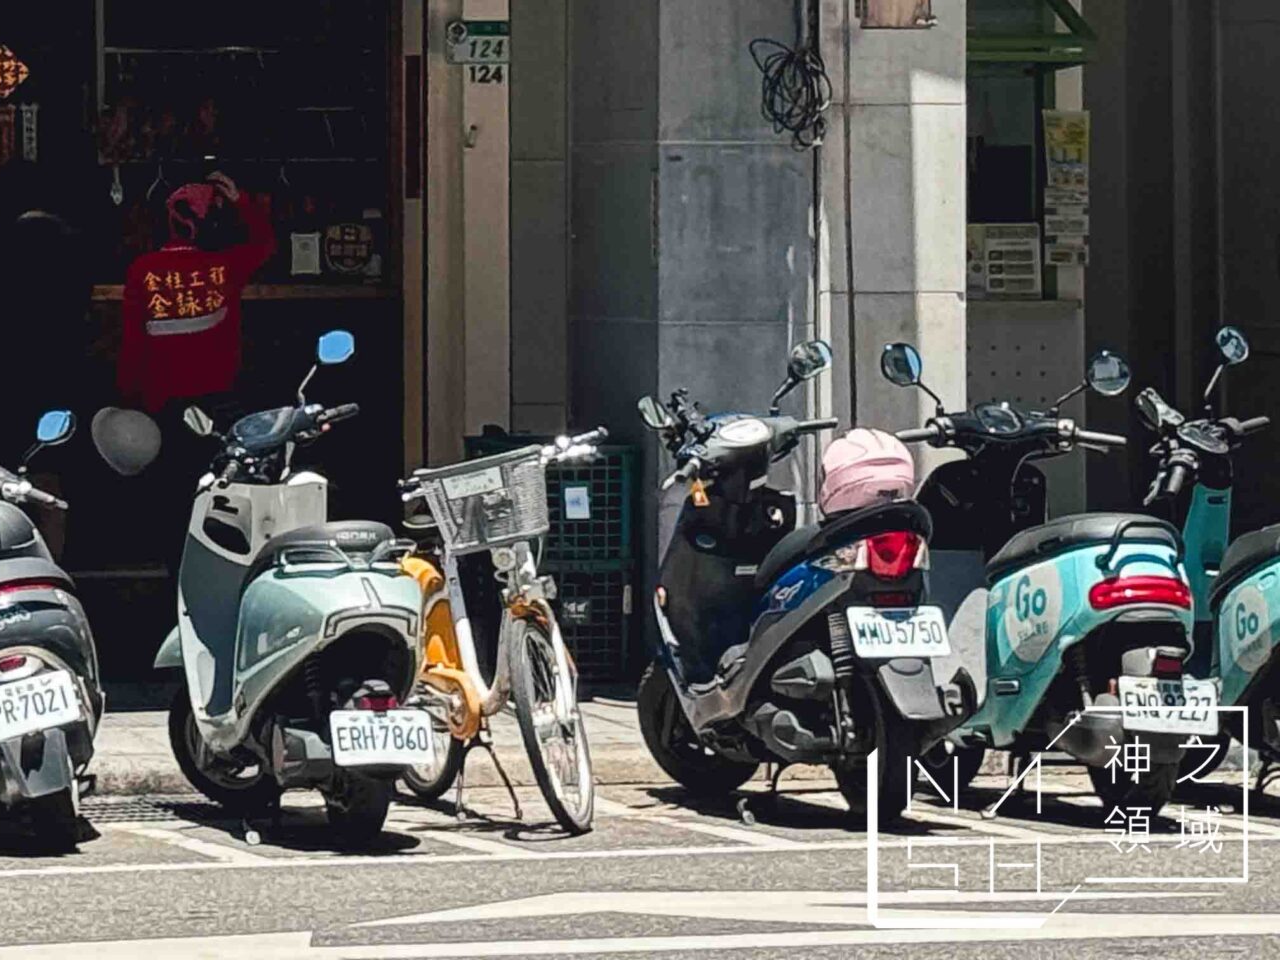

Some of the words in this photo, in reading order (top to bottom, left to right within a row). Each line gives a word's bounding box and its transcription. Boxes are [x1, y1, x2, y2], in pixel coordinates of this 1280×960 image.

[469, 40, 504, 58] 124
[468, 65, 503, 84] 124
[1016, 574, 1047, 622] Go
[1235, 602, 1259, 641] Go
[336, 725, 429, 752] ERH-7860
